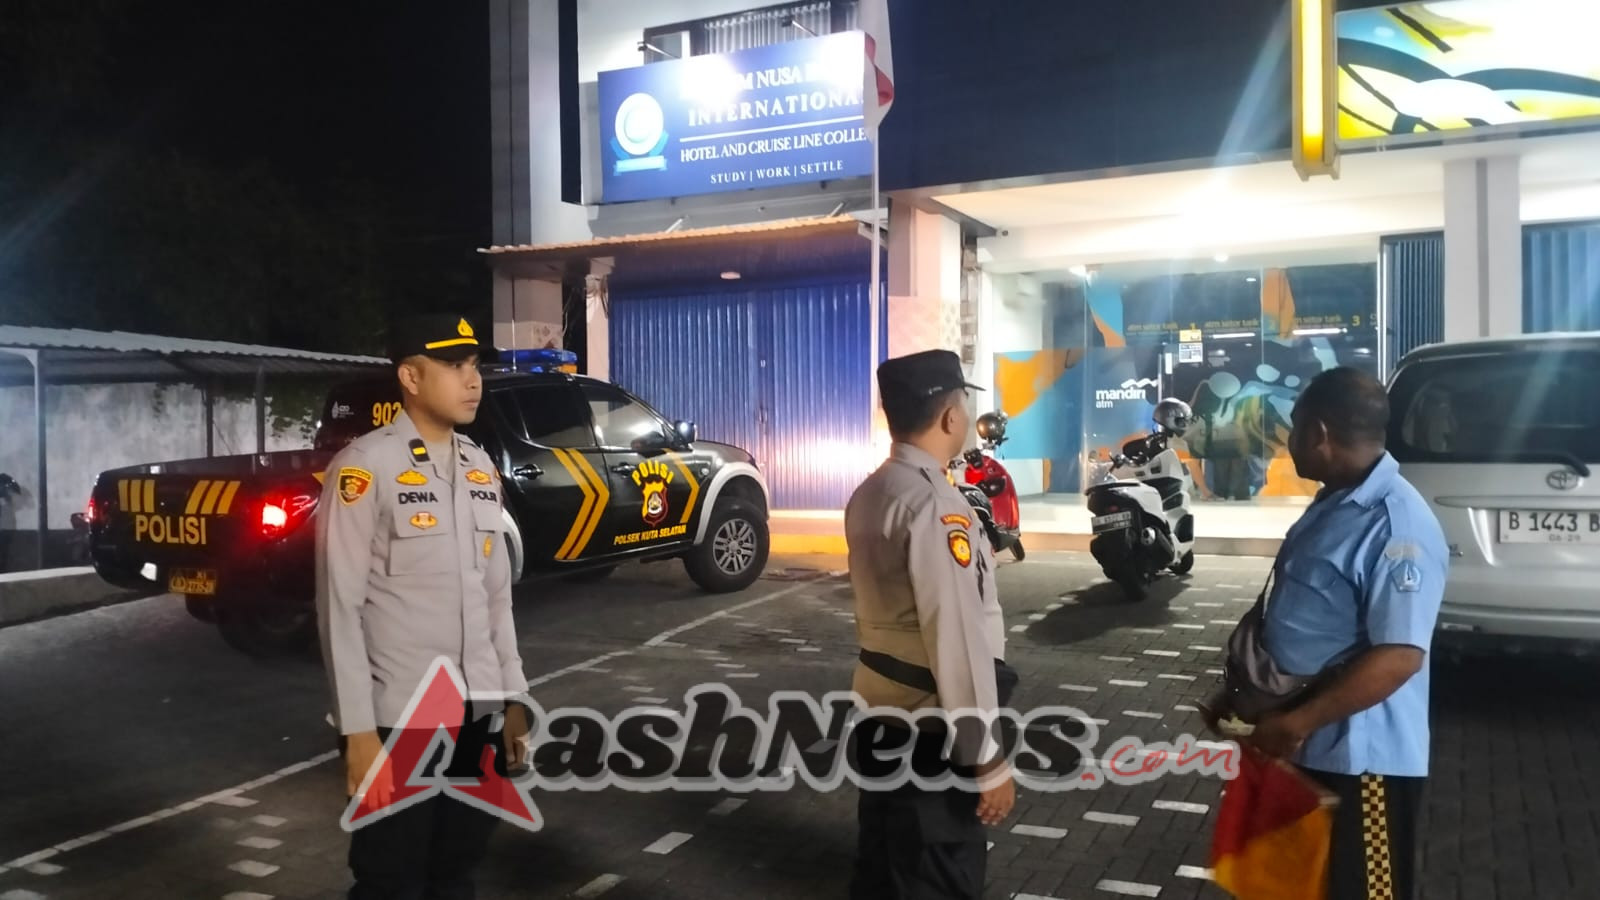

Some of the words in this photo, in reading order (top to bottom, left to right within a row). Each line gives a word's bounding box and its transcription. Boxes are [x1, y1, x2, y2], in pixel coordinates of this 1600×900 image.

[757, 65, 799, 88] NUSA
[688, 91, 865, 127] INTERNATIONA
[681, 145, 719, 162] HOTEL
[721, 142, 747, 158] AND
[748, 137, 792, 155] CRUISE
[793, 132, 822, 149] LINE
[824, 127, 867, 145] COLLE
[710, 171, 746, 184] STUDY
[756, 166, 791, 178] WORK
[800, 160, 843, 174] SETTLE
[1352, 315, 1360, 326] 3
[1096, 386, 1146, 400] mandiri
[1096, 400, 1113, 408] atm
[631, 460, 674, 486] POLISI
[398, 492, 438, 504] DEWA
[136, 515, 207, 545] POLISI
[1509, 511, 1520, 530] B
[1529, 512, 1578, 532] 1443
[613, 532, 640, 545] POLSEK
[641, 529, 658, 541] KUTA
[659, 524, 687, 538] SELATAN
